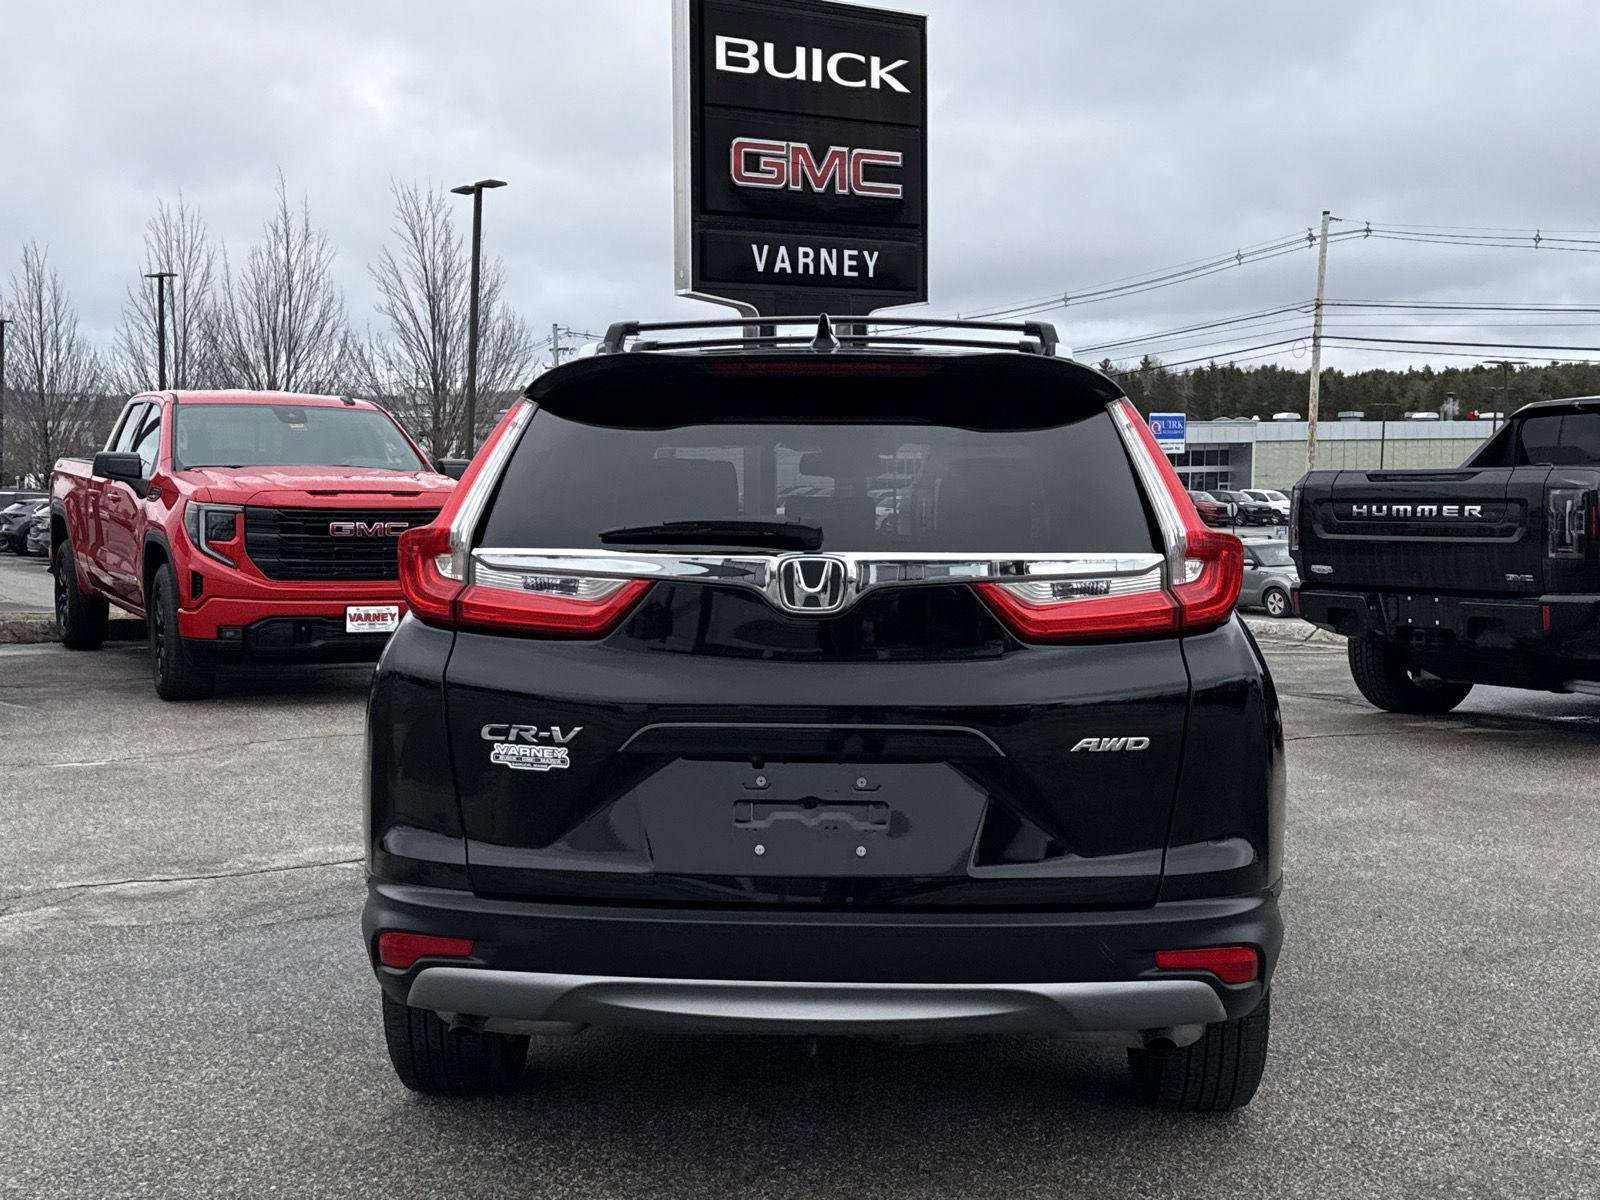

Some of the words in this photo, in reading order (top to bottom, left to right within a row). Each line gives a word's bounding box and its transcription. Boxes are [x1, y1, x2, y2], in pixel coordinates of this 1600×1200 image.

[715, 35, 911, 93] BUICK
[731, 137, 903, 199] GMC
[752, 244, 879, 278] VARNEY
[1352, 505, 1482, 518] HUMMER
[329, 522, 409, 537] GMC
[348, 612, 397, 623] VARNEY
[481, 723, 583, 743] CR-V
[495, 744, 567, 758] VARNEY
[1070, 736, 1150, 752] AWD
